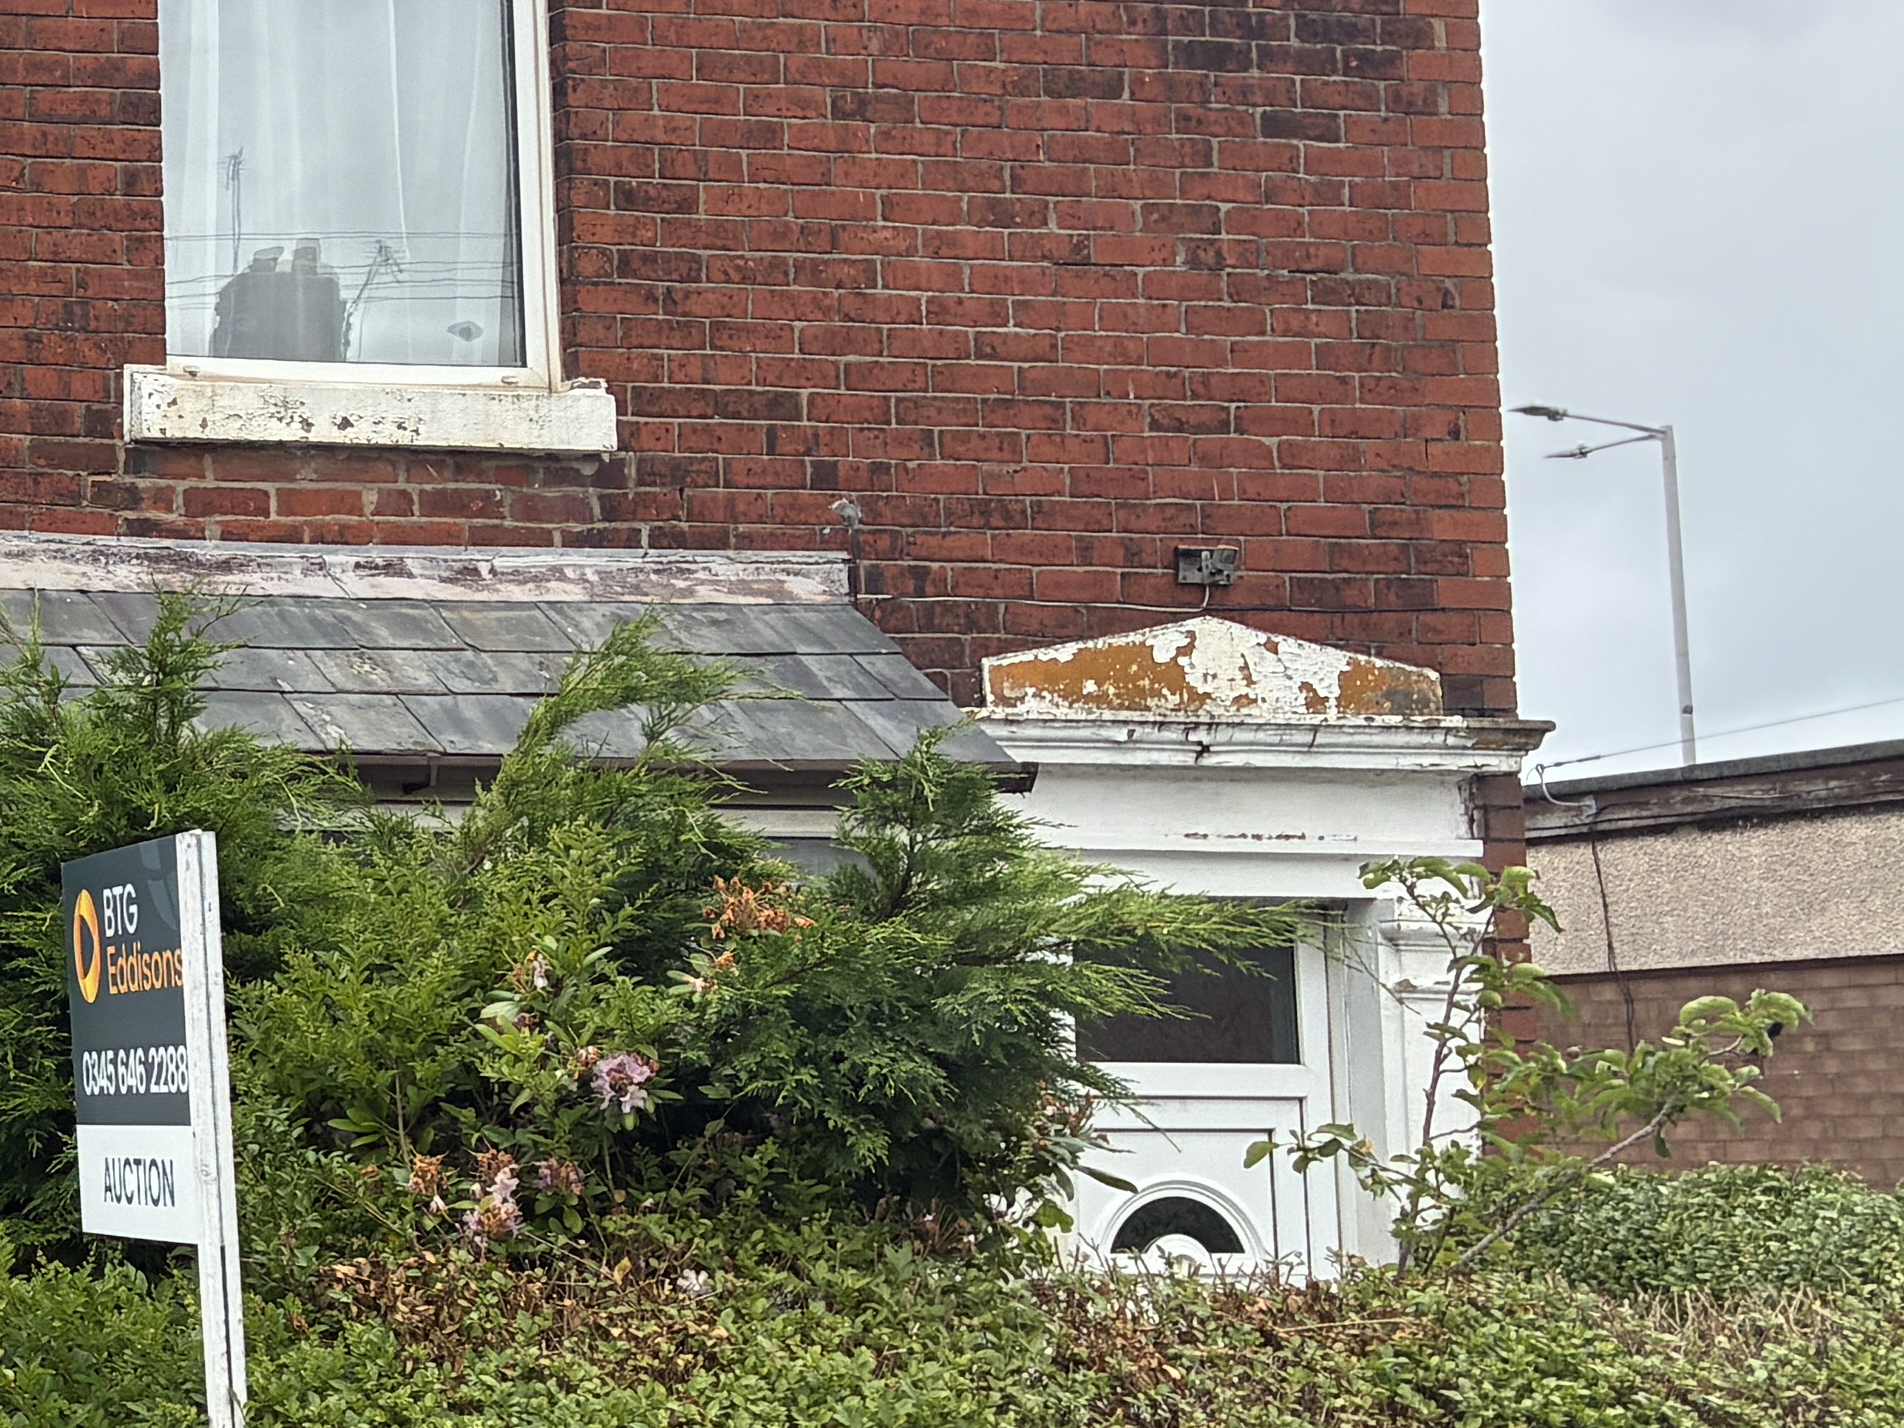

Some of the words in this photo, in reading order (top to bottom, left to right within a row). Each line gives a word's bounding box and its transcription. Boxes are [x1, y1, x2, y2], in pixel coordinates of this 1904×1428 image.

[103, 883, 138, 938] BTG
[107, 940, 183, 994] Eddisons
[82, 1050, 116, 1095] 0345
[117, 1047, 146, 1094] 646
[148, 1045, 188, 1093] 2288
[104, 1157, 175, 1207] AUCTION
